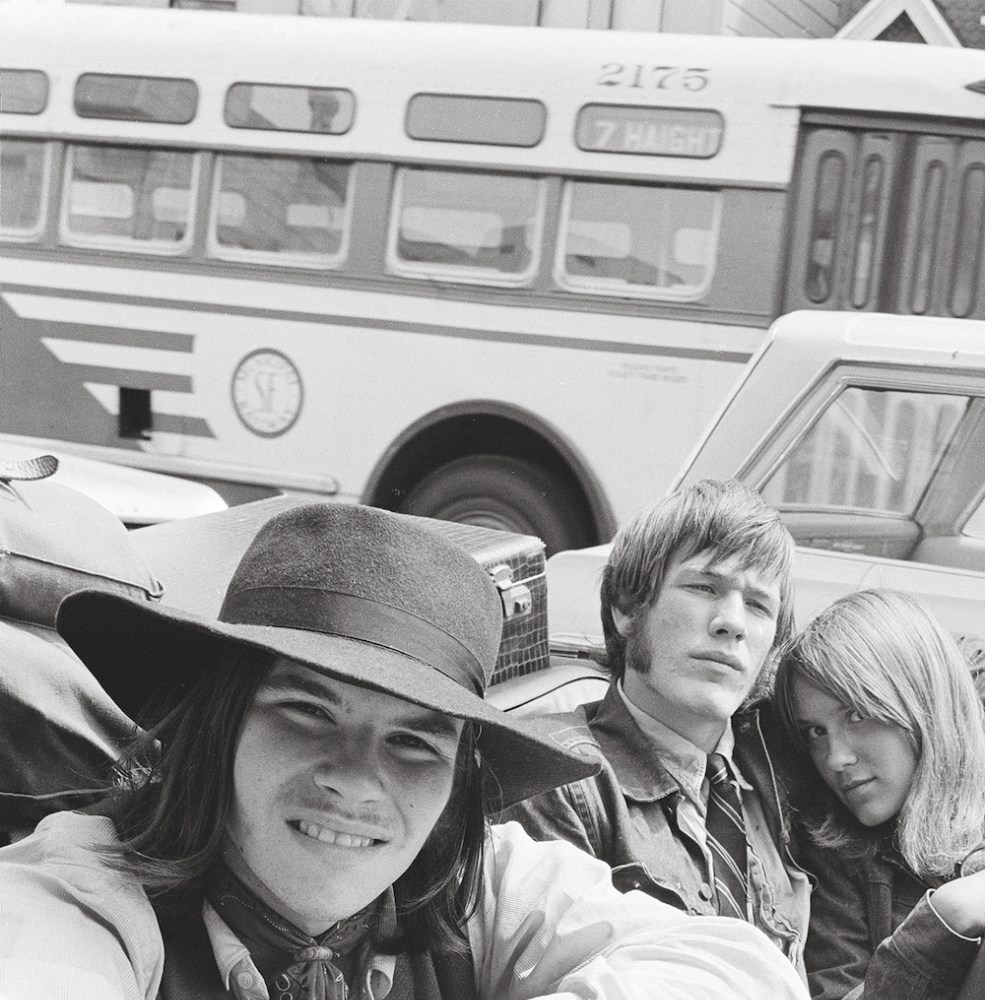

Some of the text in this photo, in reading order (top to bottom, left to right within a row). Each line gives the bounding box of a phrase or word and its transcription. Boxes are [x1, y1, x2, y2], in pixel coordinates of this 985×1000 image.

[597, 63, 710, 92] 2175
[593, 119, 722, 154] 7 HAIGHT
